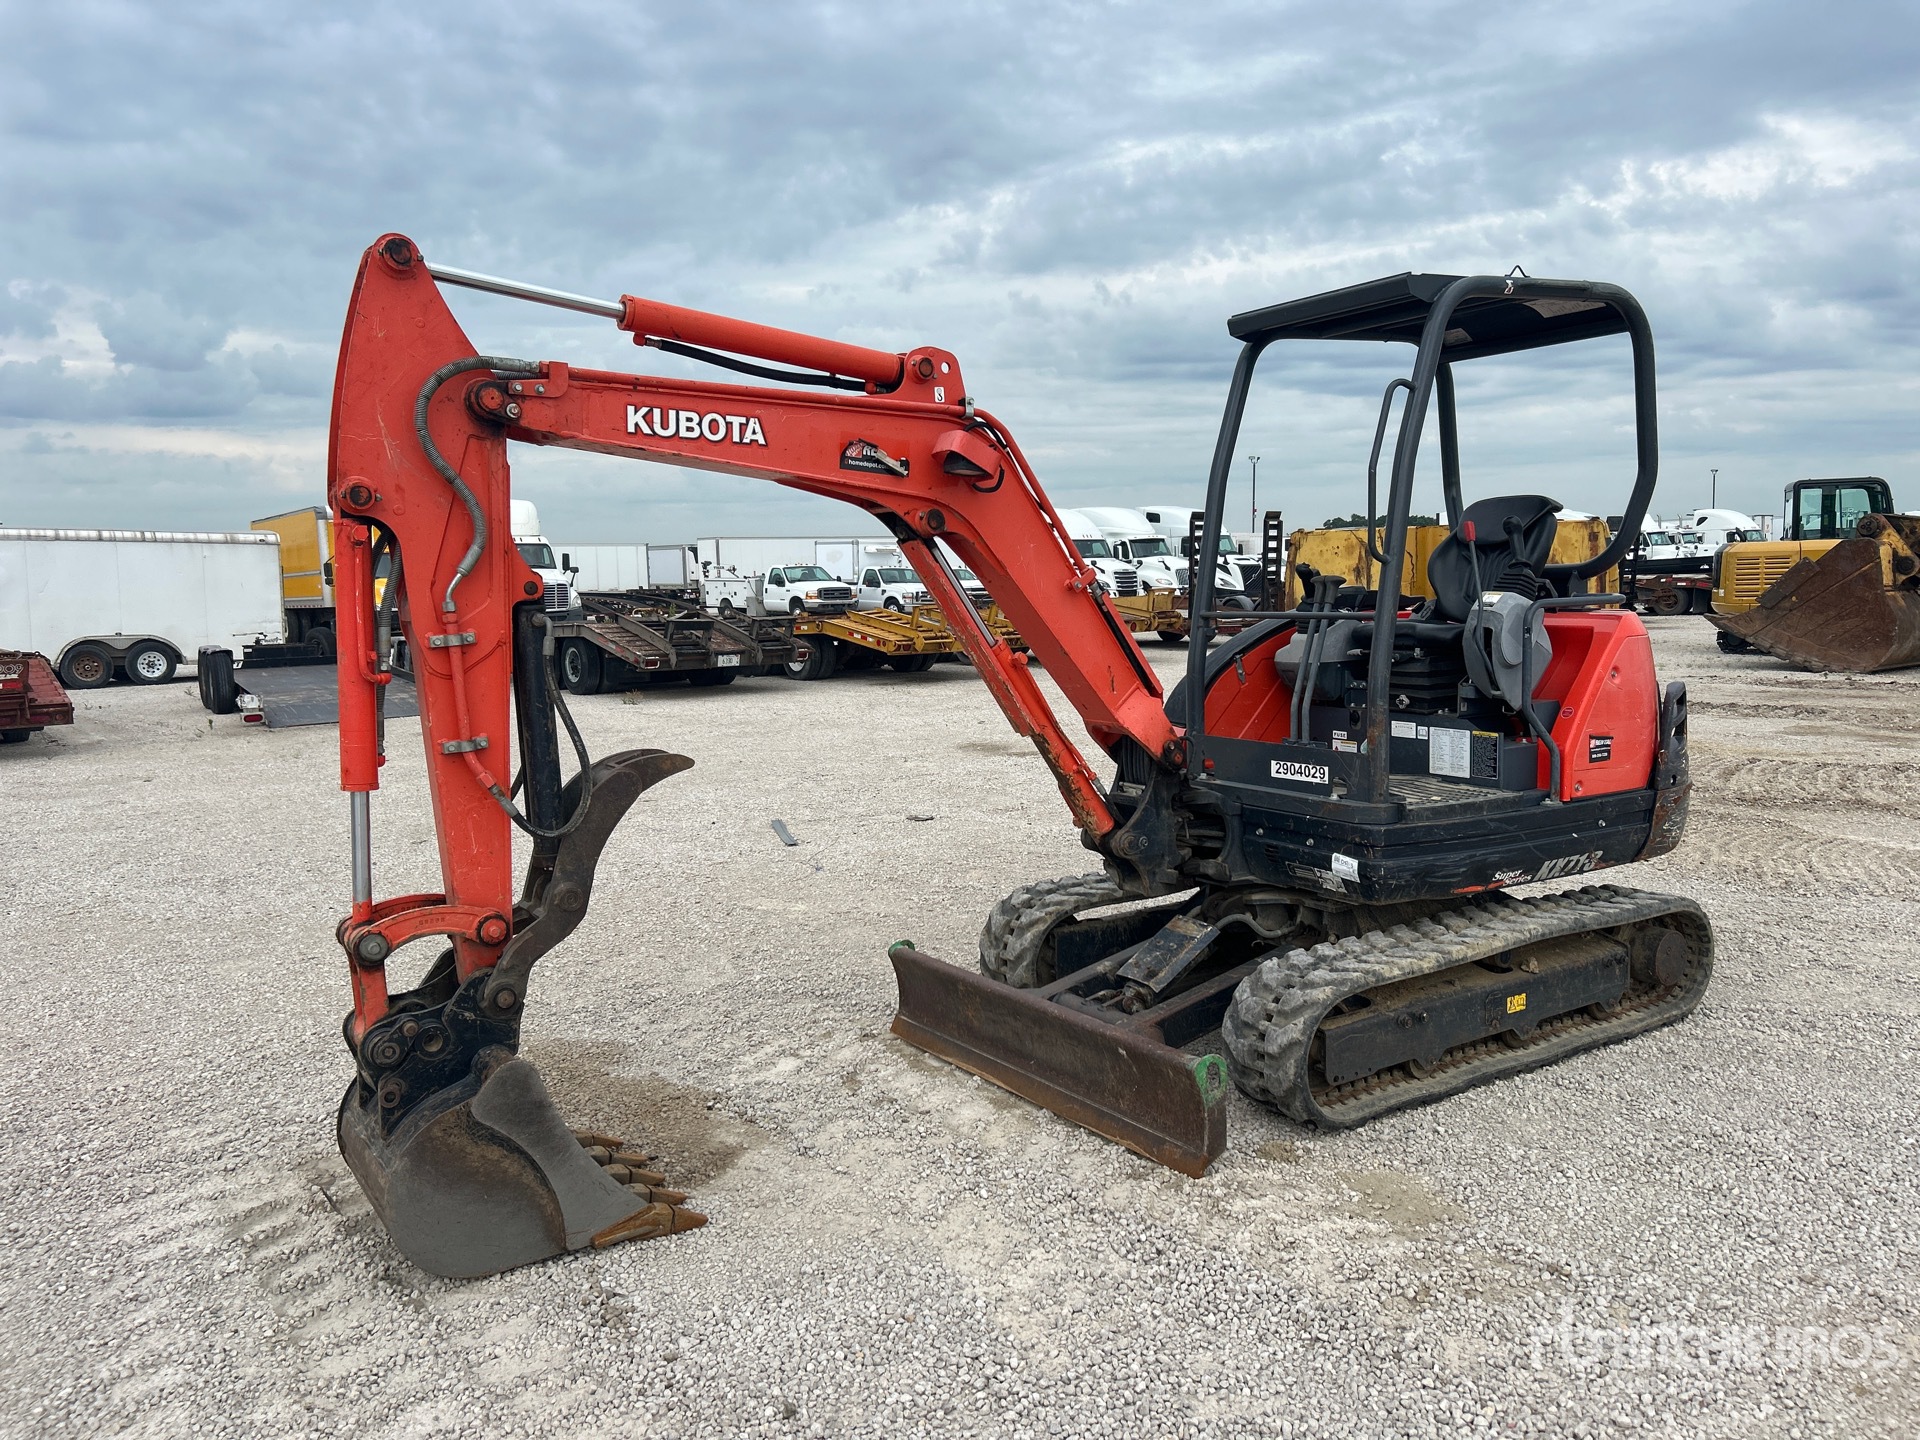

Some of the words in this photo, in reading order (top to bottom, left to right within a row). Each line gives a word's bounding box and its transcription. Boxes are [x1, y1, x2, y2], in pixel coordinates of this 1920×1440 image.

[626, 404, 767, 446] KUBOTA
[1275, 761, 1326, 780] 2904029
[1492, 869, 1522, 881] Super
[1504, 873, 1532, 885] Series
